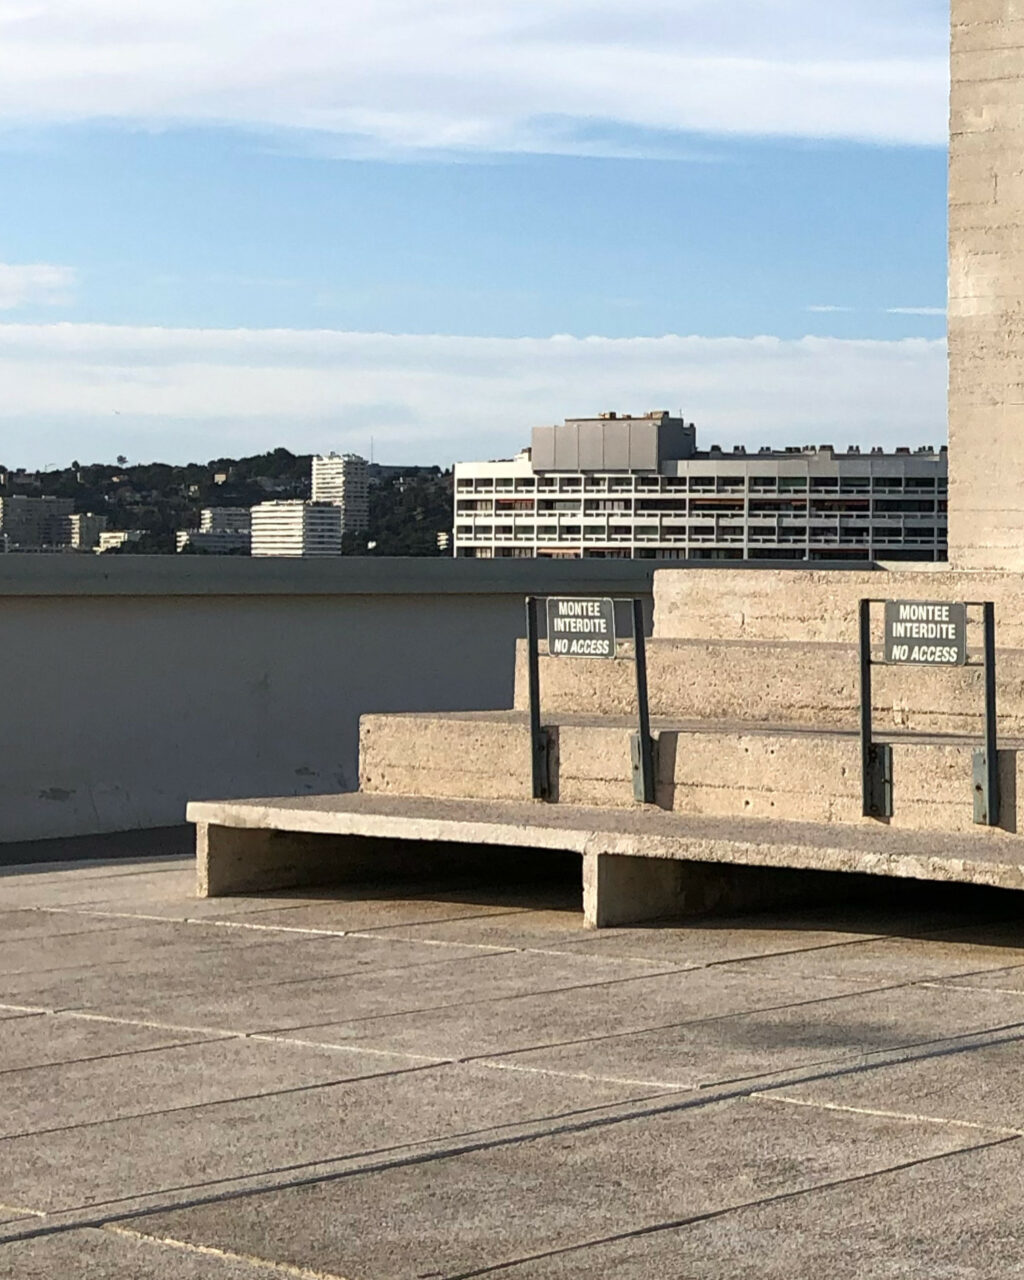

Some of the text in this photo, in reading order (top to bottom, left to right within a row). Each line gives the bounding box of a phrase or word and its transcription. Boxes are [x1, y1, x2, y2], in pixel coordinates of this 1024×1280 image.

[559, 601, 601, 616] MONTEE
[899, 605, 950, 621] MONTEE
[554, 618, 607, 633] INTERDITE
[892, 622, 956, 639] INTERDITE
[554, 638, 610, 654] NO ACCESS
[892, 644, 958, 662] NO ACCESS
